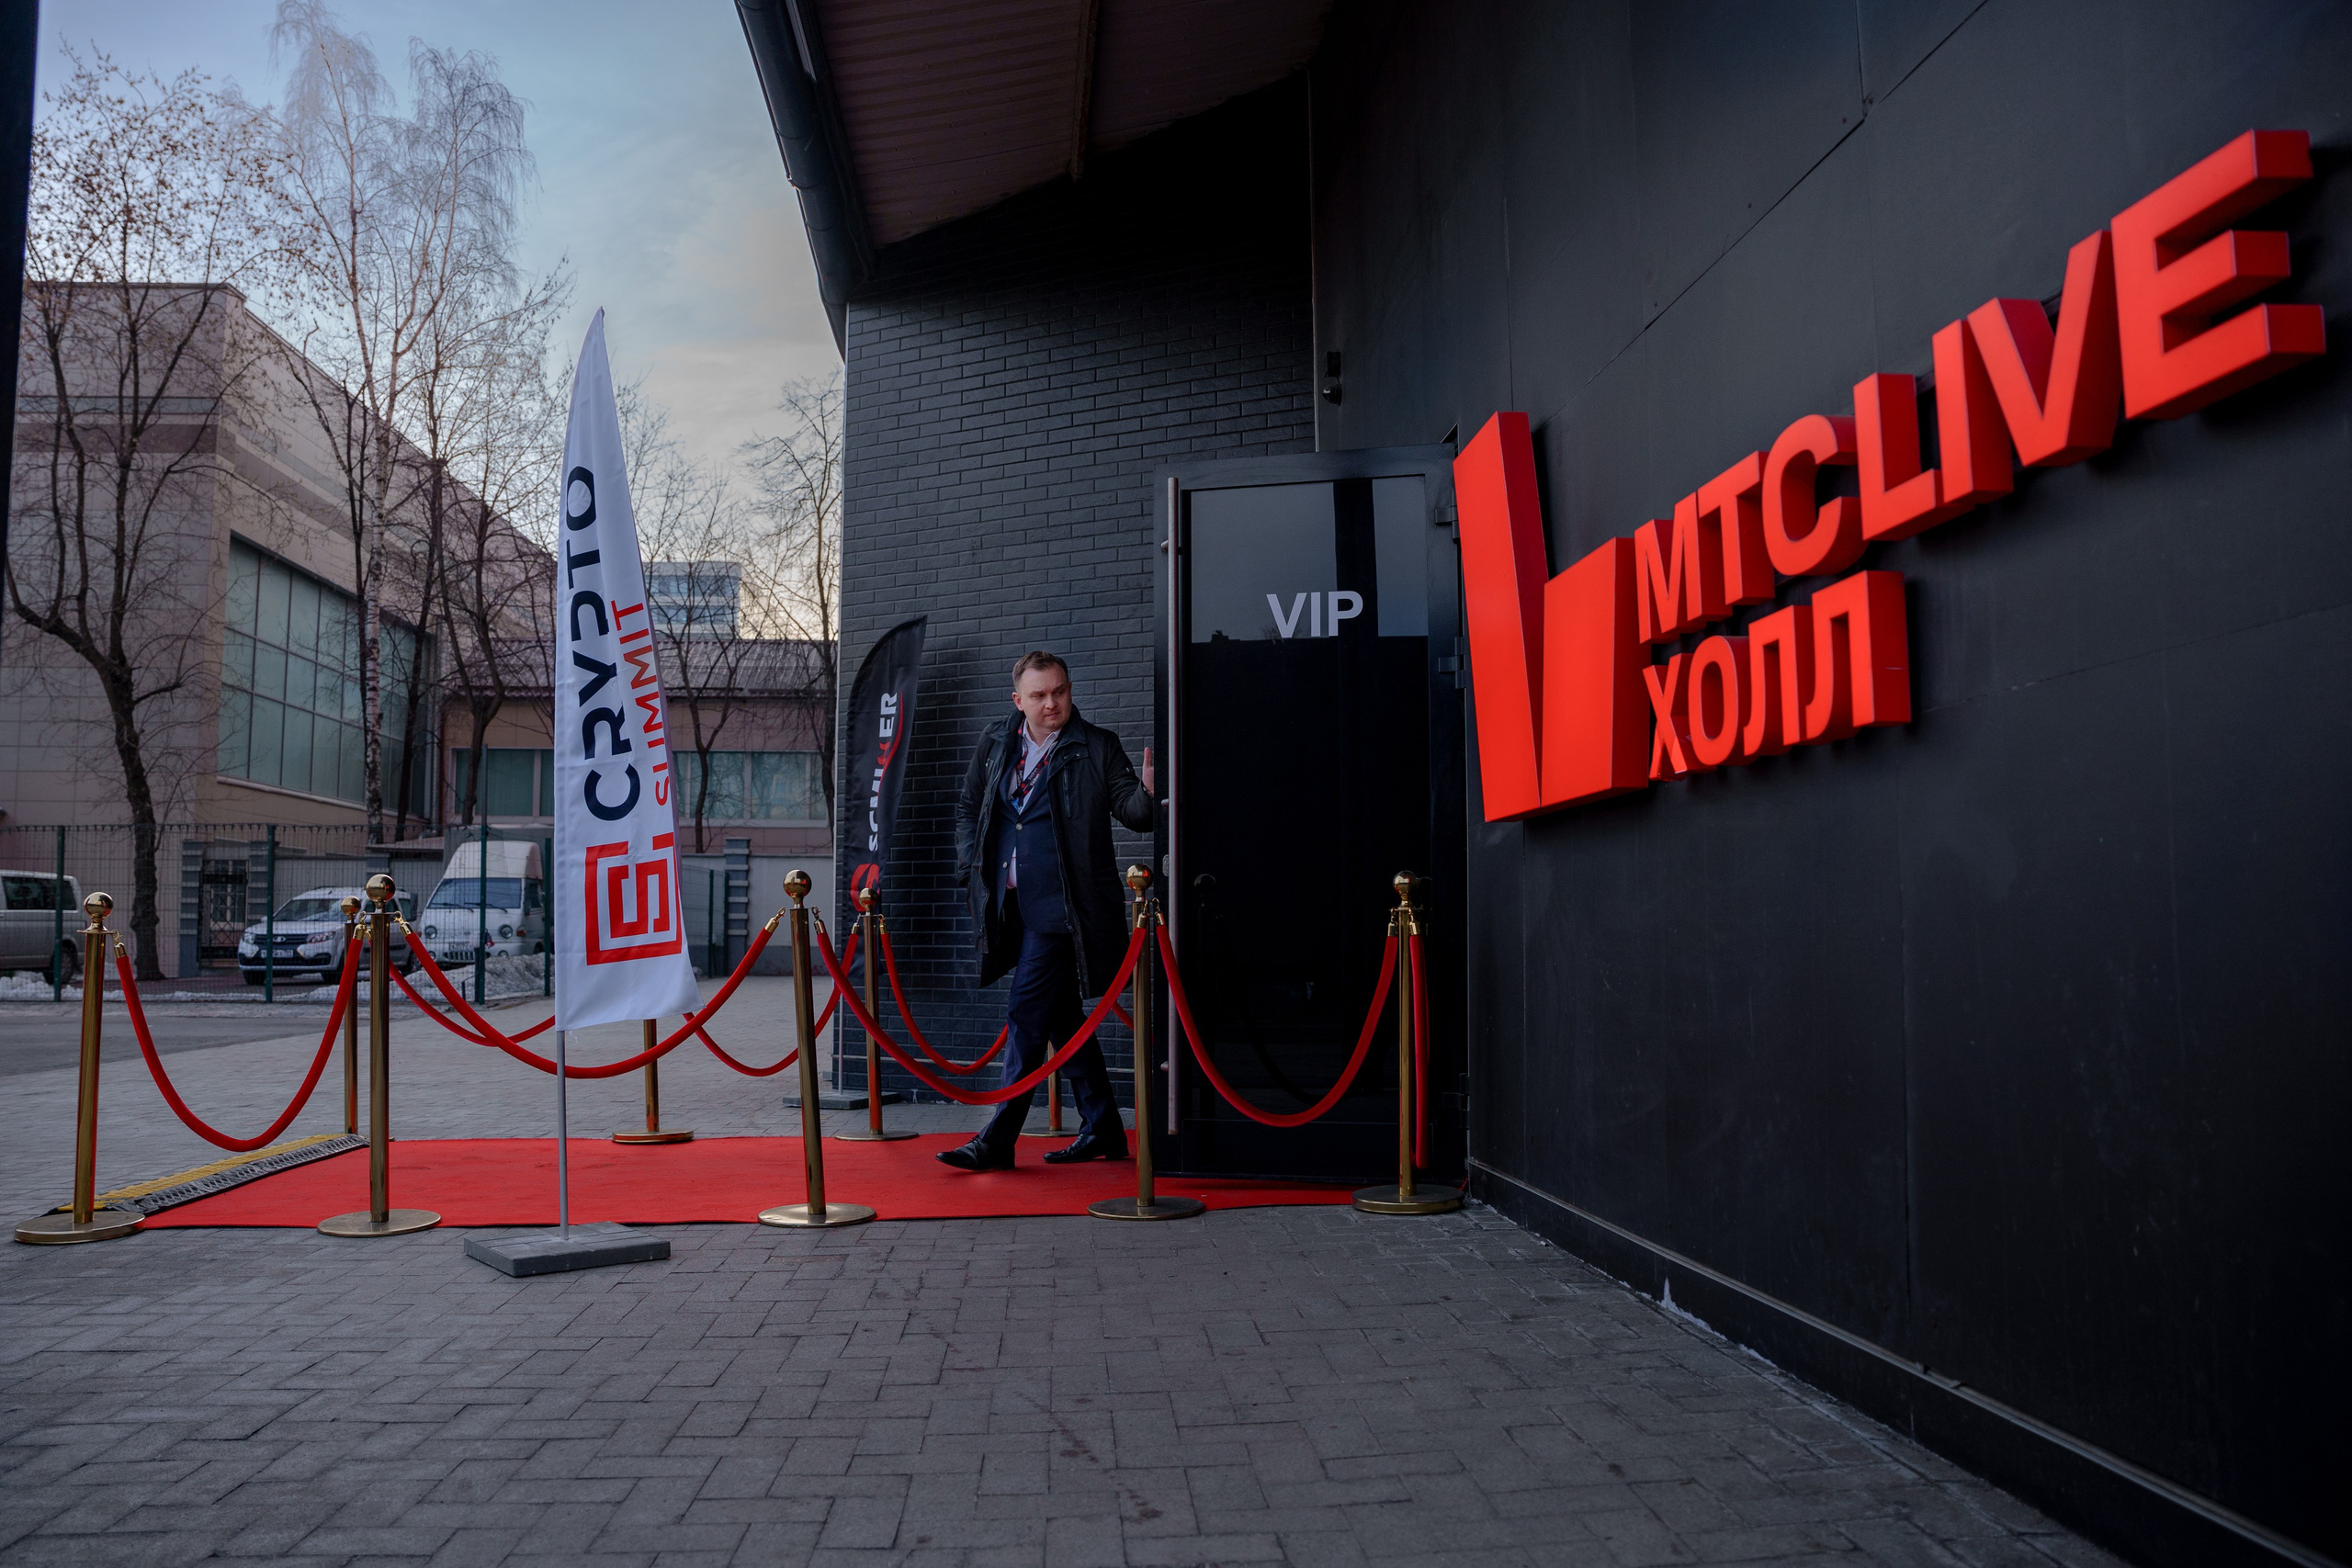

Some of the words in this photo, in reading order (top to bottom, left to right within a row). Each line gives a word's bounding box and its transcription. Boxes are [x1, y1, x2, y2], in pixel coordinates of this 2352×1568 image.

[1852, 129, 2326, 543] LIVE
[566, 465, 641, 821] CRYPTO
[611, 600, 670, 807] SUMMIT
[1266, 590, 1363, 638] VIP
[1642, 570, 1911, 781] ХОЛЛ
